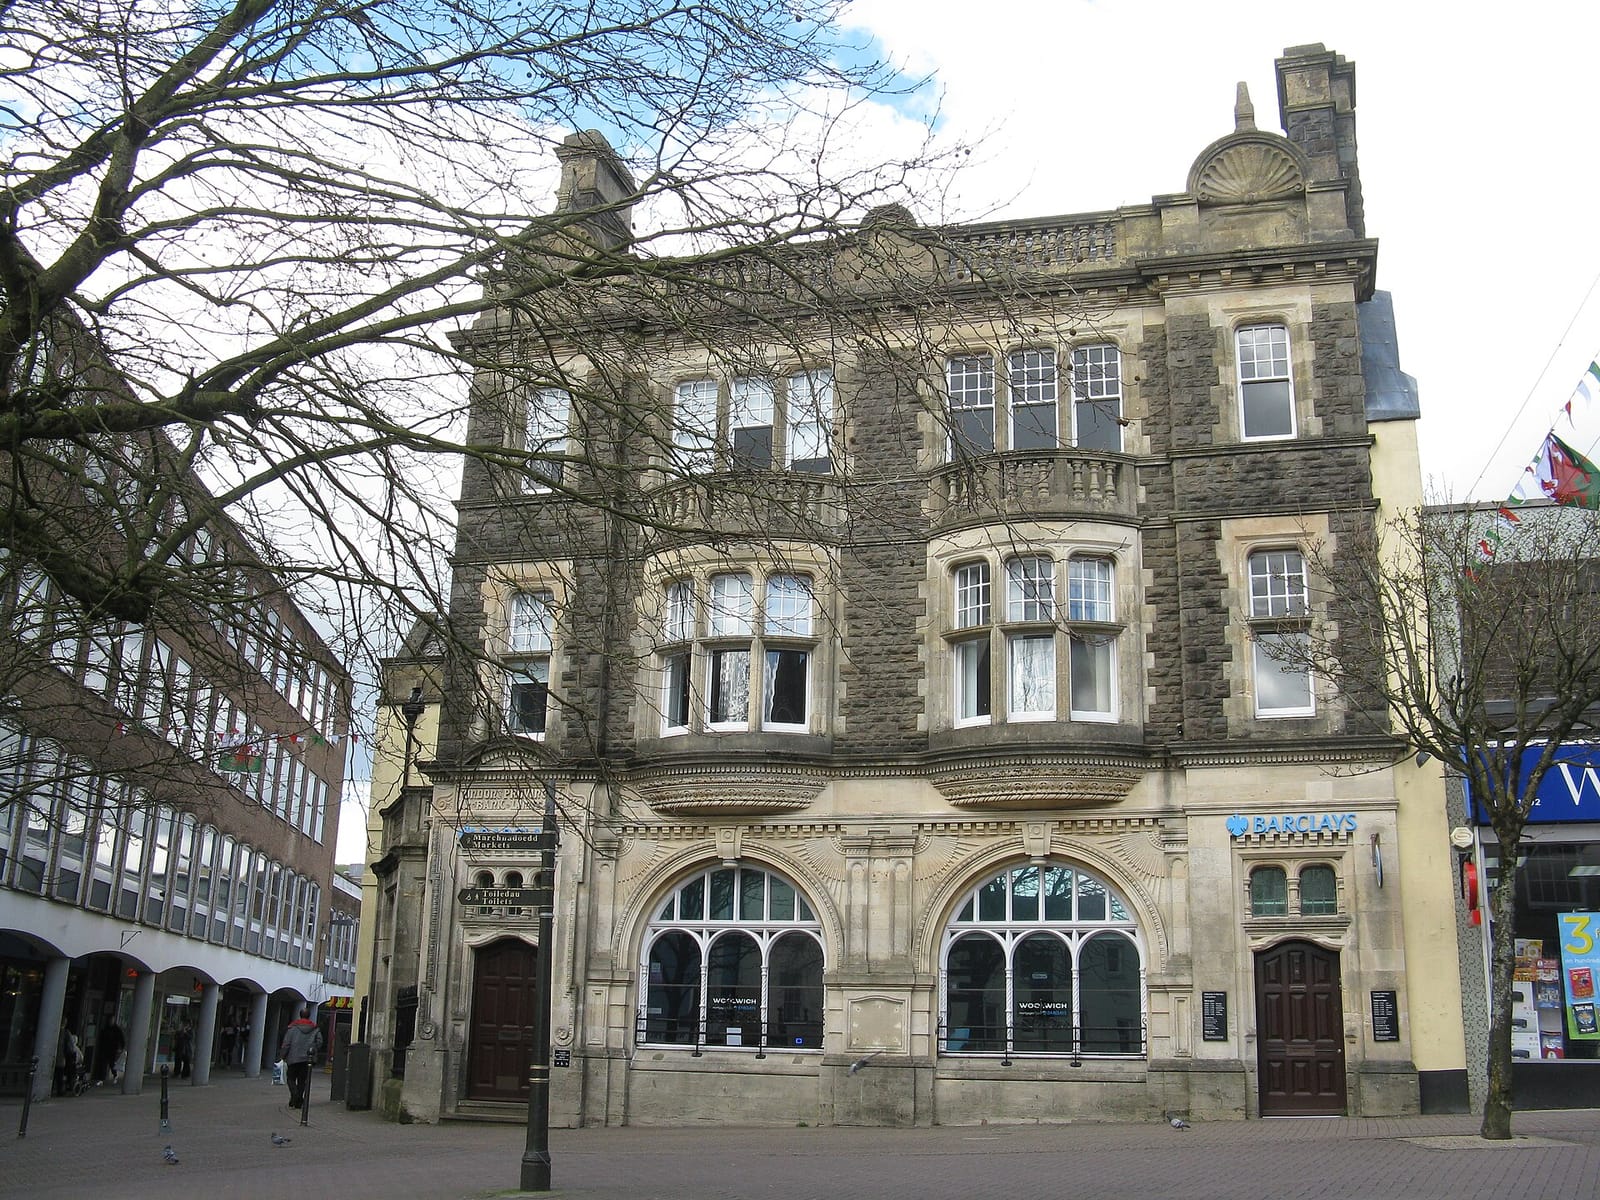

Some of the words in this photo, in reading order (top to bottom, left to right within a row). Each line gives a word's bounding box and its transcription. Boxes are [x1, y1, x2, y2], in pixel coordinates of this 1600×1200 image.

[1253, 813, 1357, 833] BARCLAYS
[473, 841, 511, 849] Markets
[482, 890, 520, 898] Toiledau
[1563, 916, 1593, 955] 3
